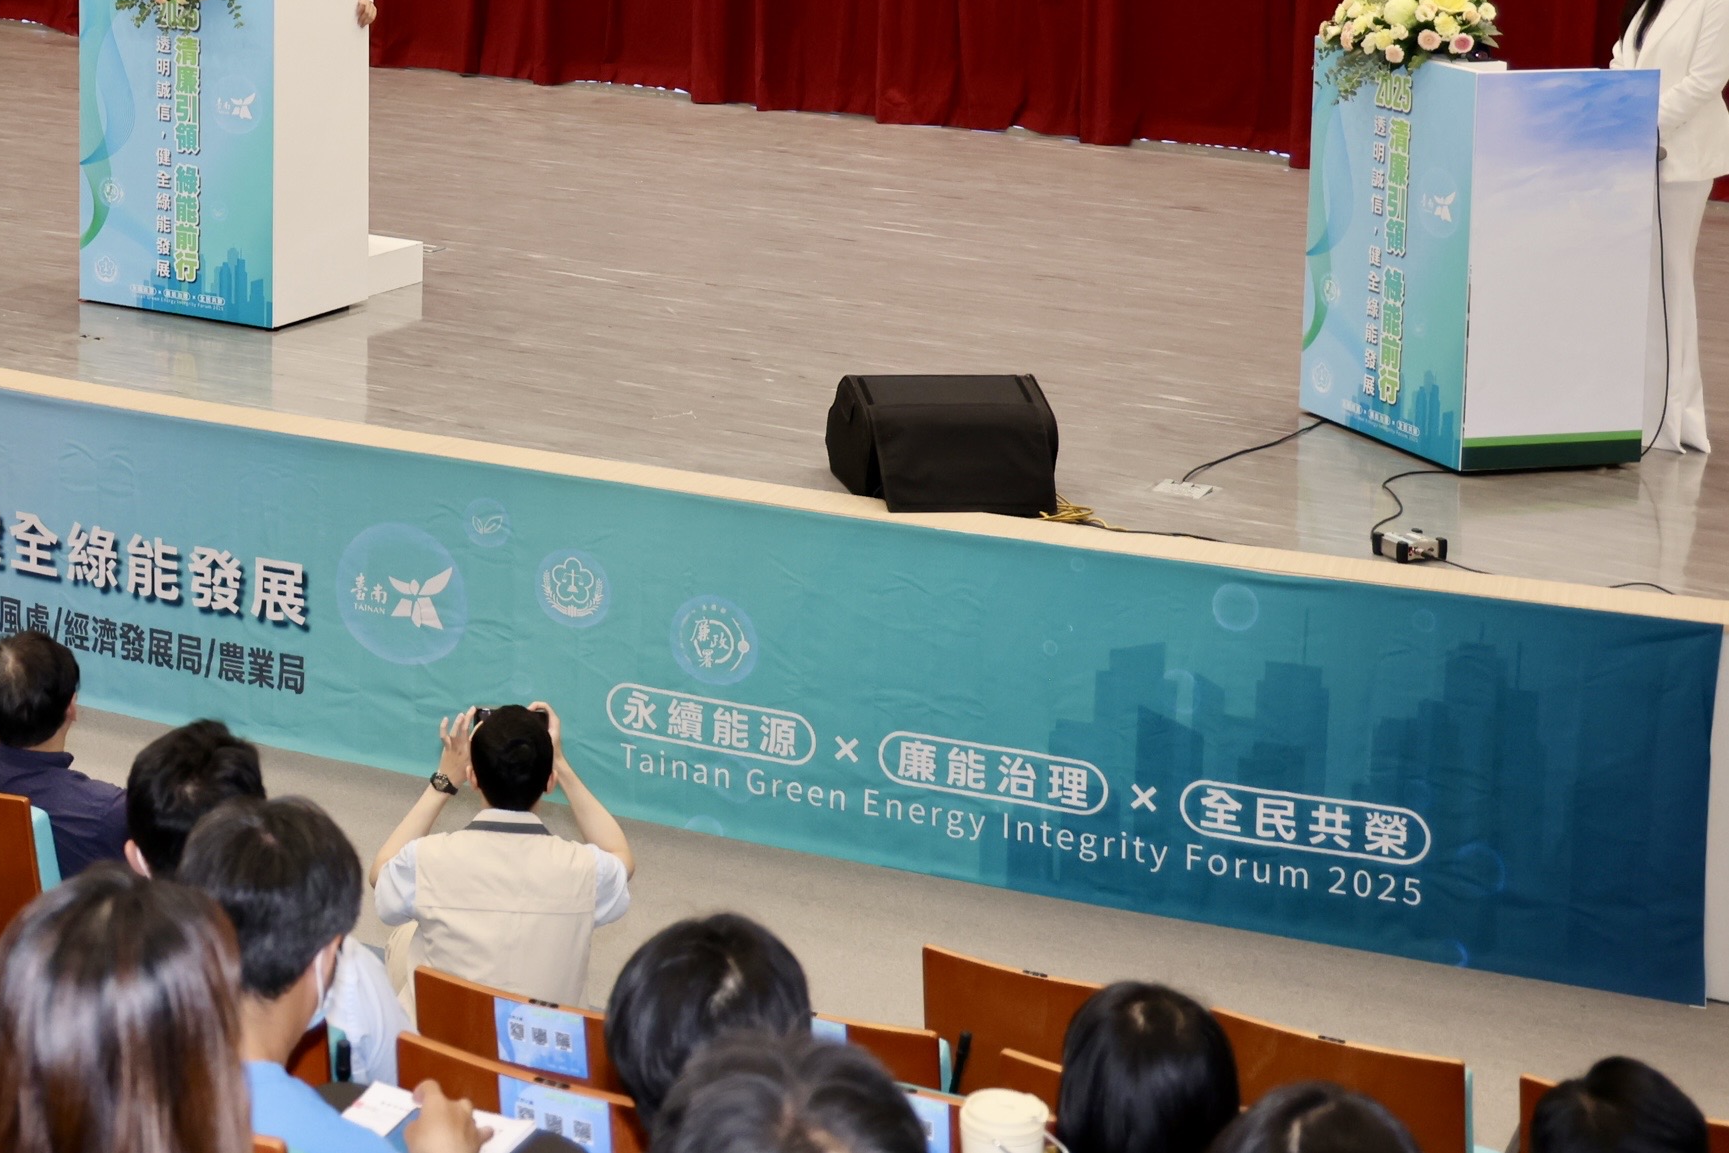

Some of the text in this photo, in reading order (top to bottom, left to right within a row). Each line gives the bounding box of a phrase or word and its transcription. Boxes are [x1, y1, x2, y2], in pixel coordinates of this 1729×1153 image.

[174, 35, 199, 155] 清廉引領
[1375, 71, 1412, 113] 2025
[174, 164, 200, 282] 綠能前行
[1385, 116, 1411, 256] 清廉引領
[1378, 265, 1404, 405] 綠能前行
[351, 572, 388, 605] 臺南
[354, 603, 386, 615] TAINAN
[619, 743, 1424, 908] Tainan Green Energy Integrity Forum 2025
[622, 691, 797, 758] 永續能源
[896, 740, 1090, 809] 廉能治理
[1199, 788, 1410, 858] 全民共榮
